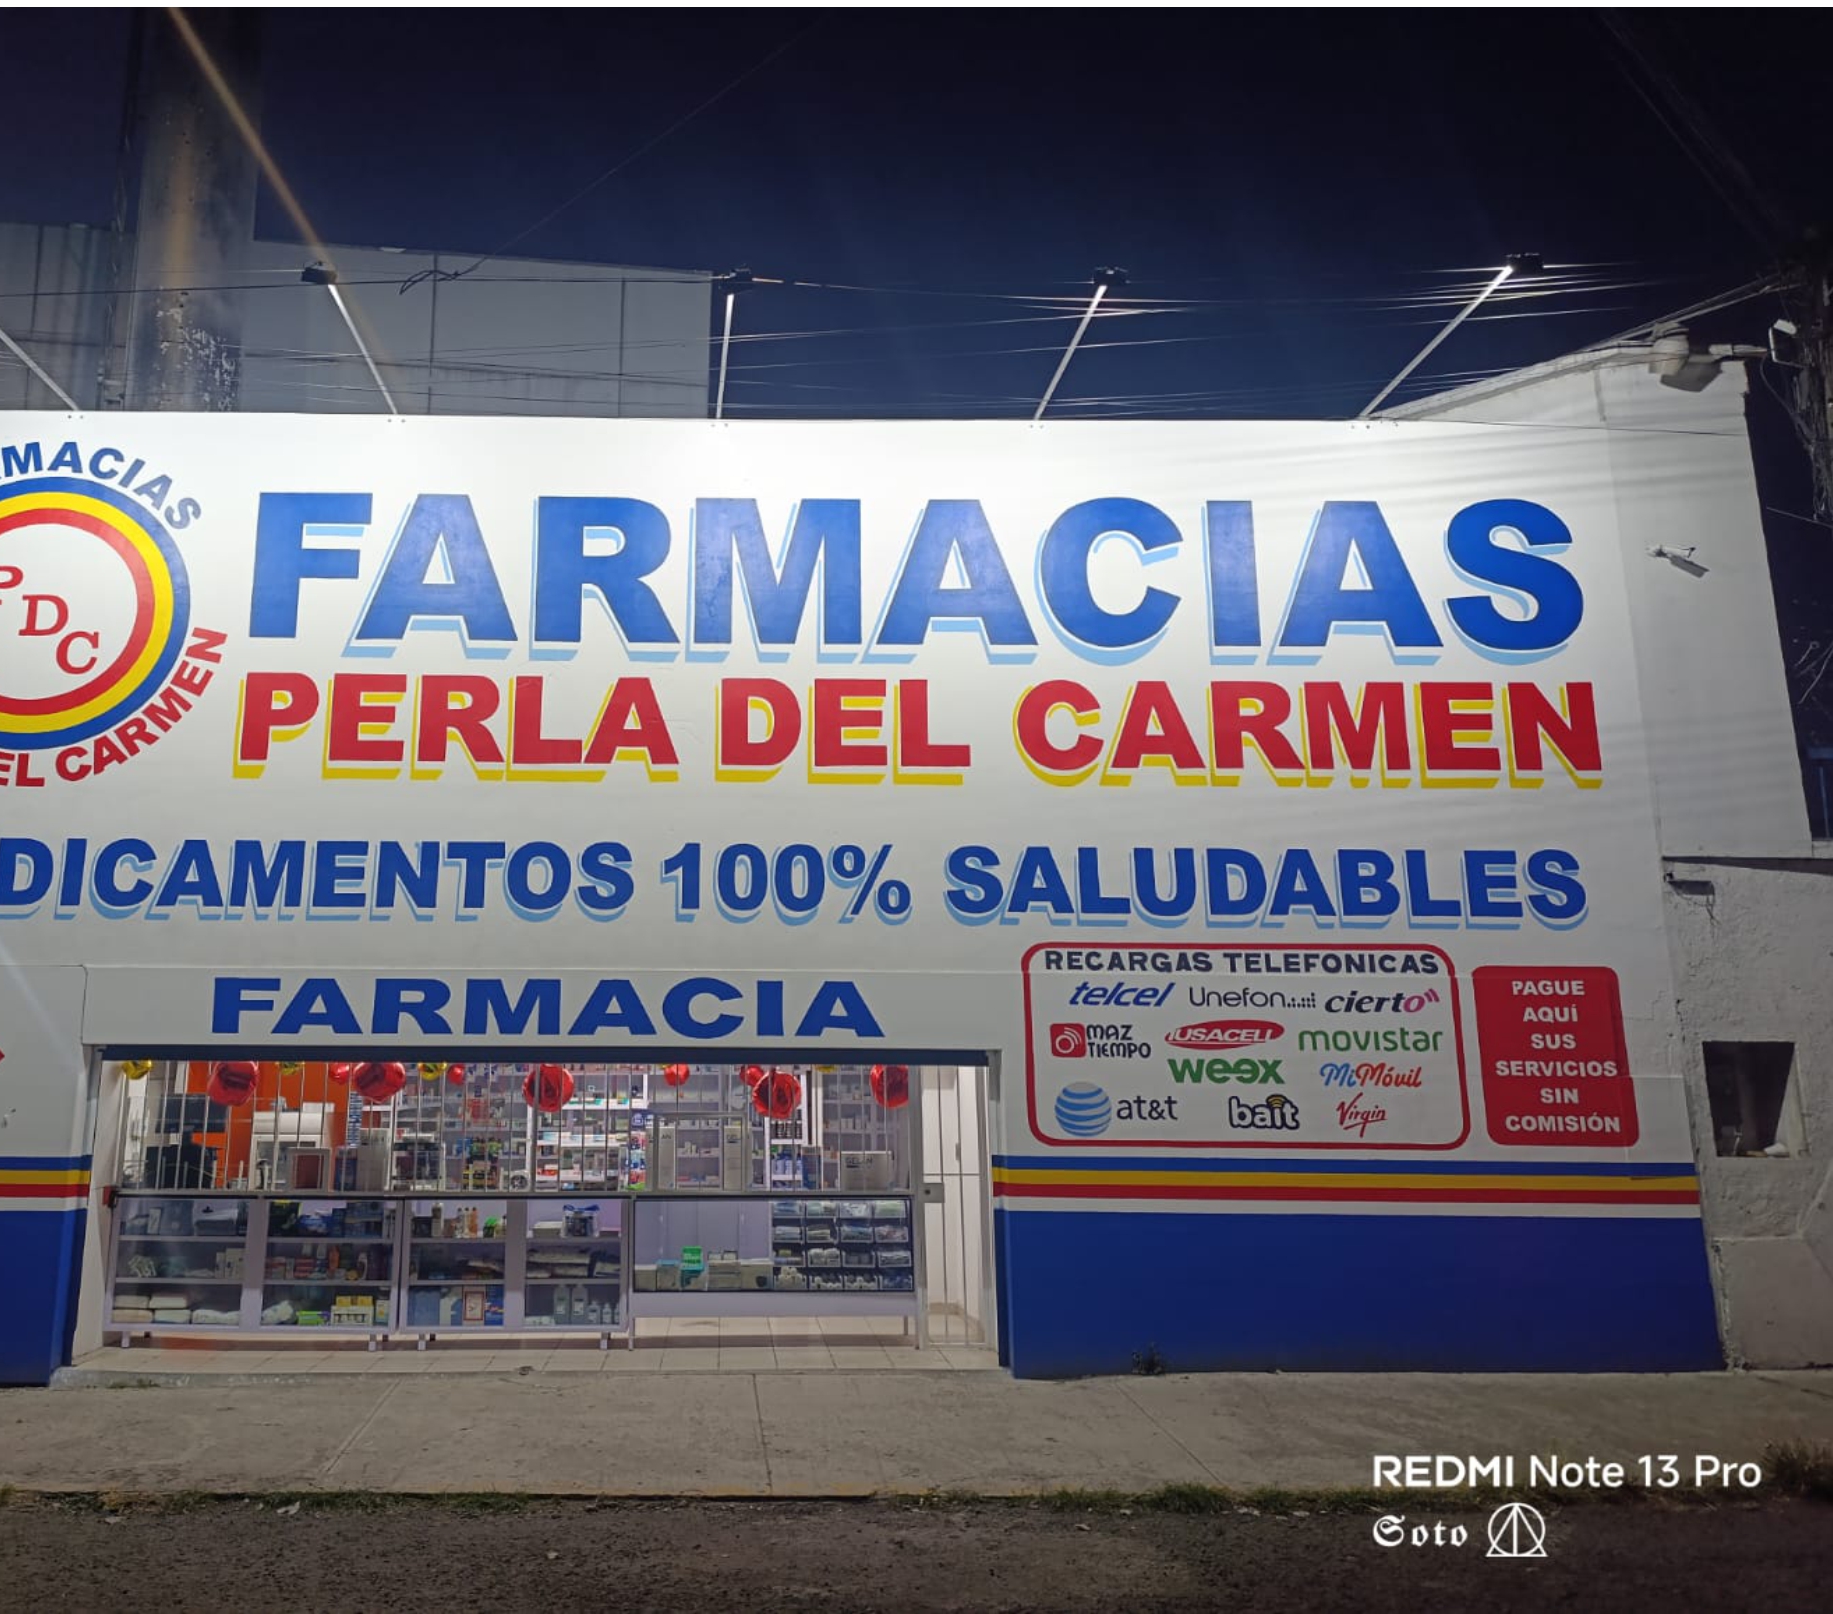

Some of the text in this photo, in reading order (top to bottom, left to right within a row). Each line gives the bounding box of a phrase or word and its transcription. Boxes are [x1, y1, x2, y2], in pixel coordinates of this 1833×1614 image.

[246, 492, 1585, 655] FARMACIAS
[54, 627, 229, 783] CARMEN
[236, 672, 1604, 777] PERLA DEL CARMEN
[662, 843, 912, 919] 100%
[946, 846, 1588, 921] SALUDABLES
[1045, 950, 1440, 975] RECARGAS TELEFONICAS
[1068, 981, 1428, 1014] telcel Unefon cierto
[1512, 980, 1586, 996] PAGUE
[211, 977, 886, 1040] FARMACIA
[1523, 1003, 1579, 1023] AQUÍ
[1298, 1026, 1444, 1053] movistar
[1530, 1033, 1577, 1050] SUS
[1166, 1057, 1286, 1085] weex
[1495, 1060, 1619, 1077] SERVICIOS
[1116, 1095, 1178, 1121] at&t
[1540, 1087, 1580, 1104] SIN
[1228, 1094, 1300, 1130] bait
[1336, 1092, 1388, 1138] Virgin
[1505, 1111, 1622, 1133] COMISIÓN
